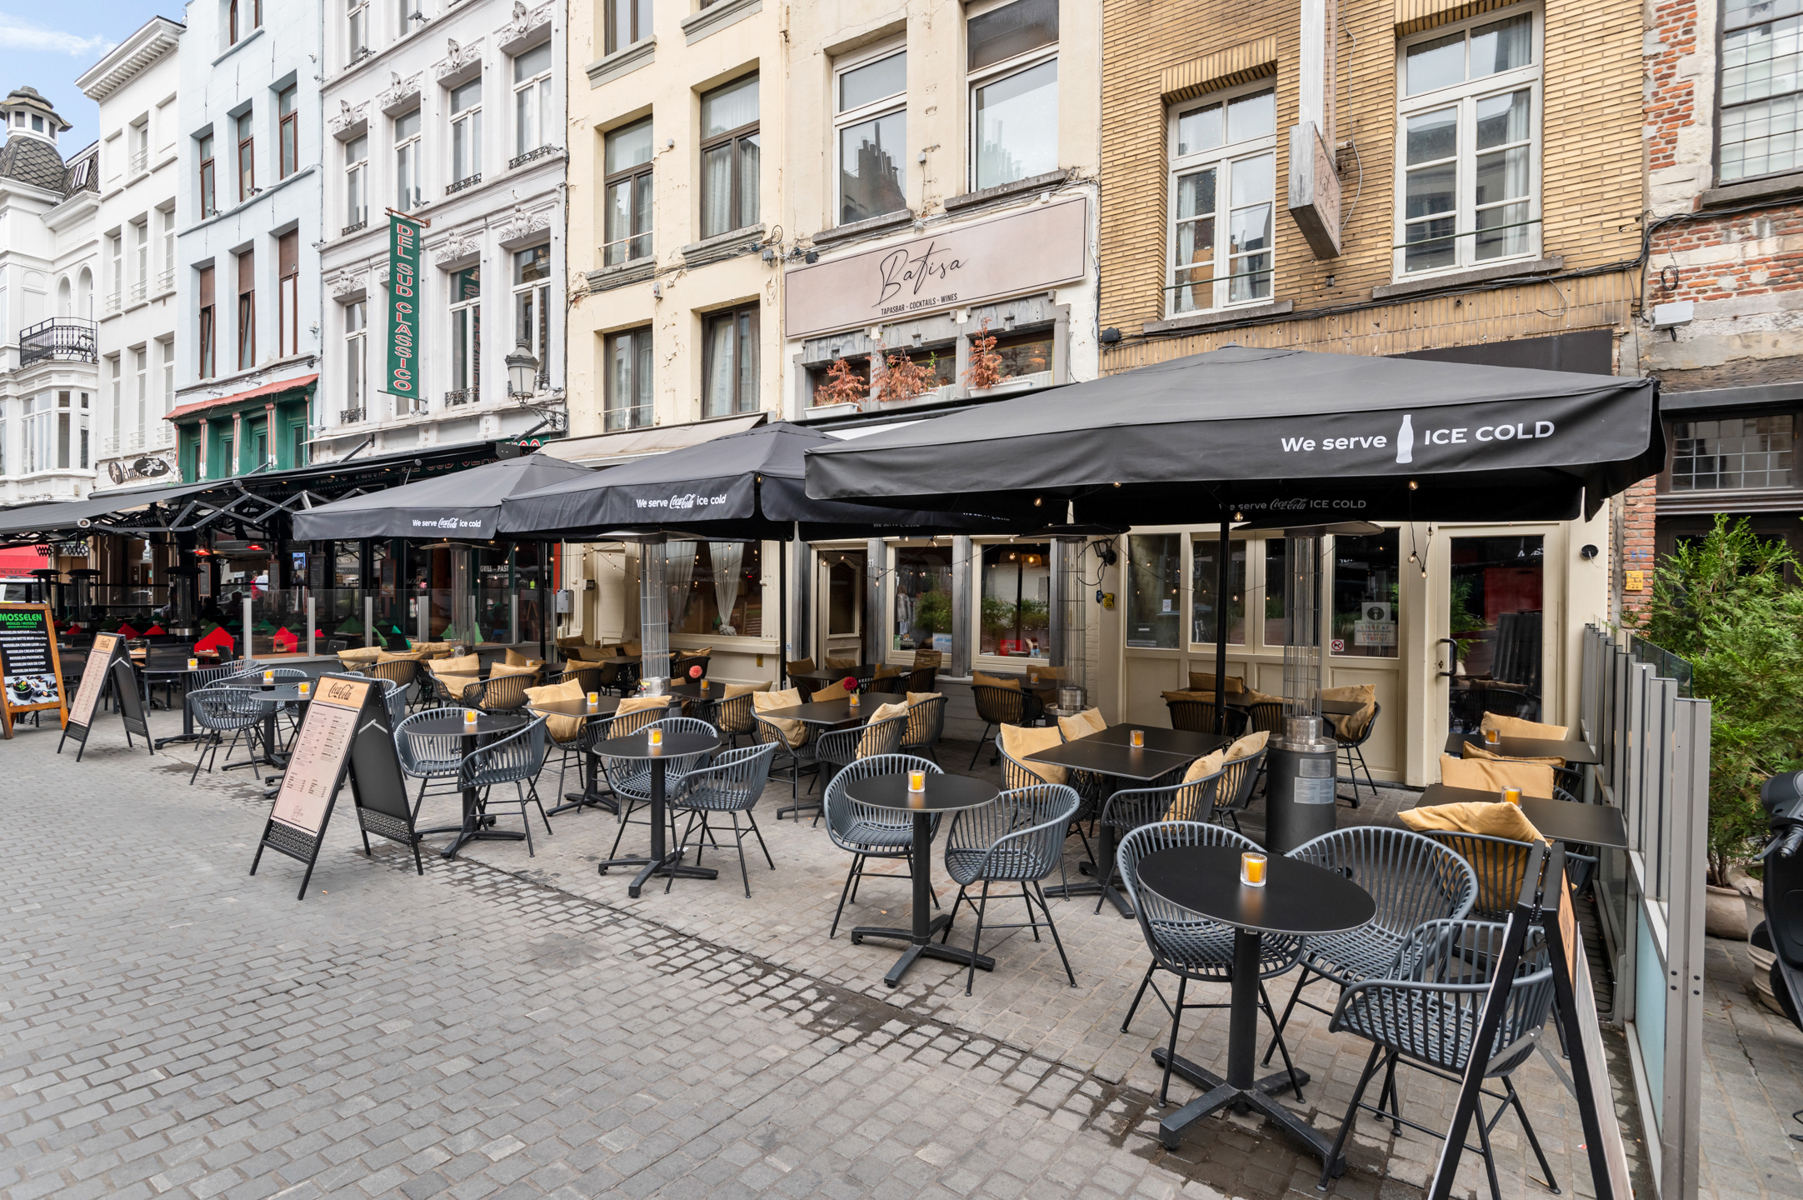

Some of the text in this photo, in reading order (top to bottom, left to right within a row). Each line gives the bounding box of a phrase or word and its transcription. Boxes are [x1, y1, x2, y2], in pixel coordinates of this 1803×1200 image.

[871, 241, 969, 308] Batisa
[393, 223, 414, 391] DEL SUD CLASSICO
[881, 304, 905, 315] TAPASBAR
[909, 297, 936, 309] COCKTAILS
[940, 293, 958, 303] WINES
[1281, 420, 1555, 453] We serve ICE COLD
[636, 499, 647, 508] We
[648, 499, 668, 508] serve
[696, 495, 709, 506] ice
[710, 494, 727, 505] cold
[1238, 502, 1267, 510] serve
[1310, 500, 1329, 509] ICE
[1332, 499, 1366, 509] COLD
[412, 519, 421, 527] We
[459, 519, 468, 528] ice
[468, 519, 482, 528] cold
[0, 613, 42, 621] MOSSELEN
